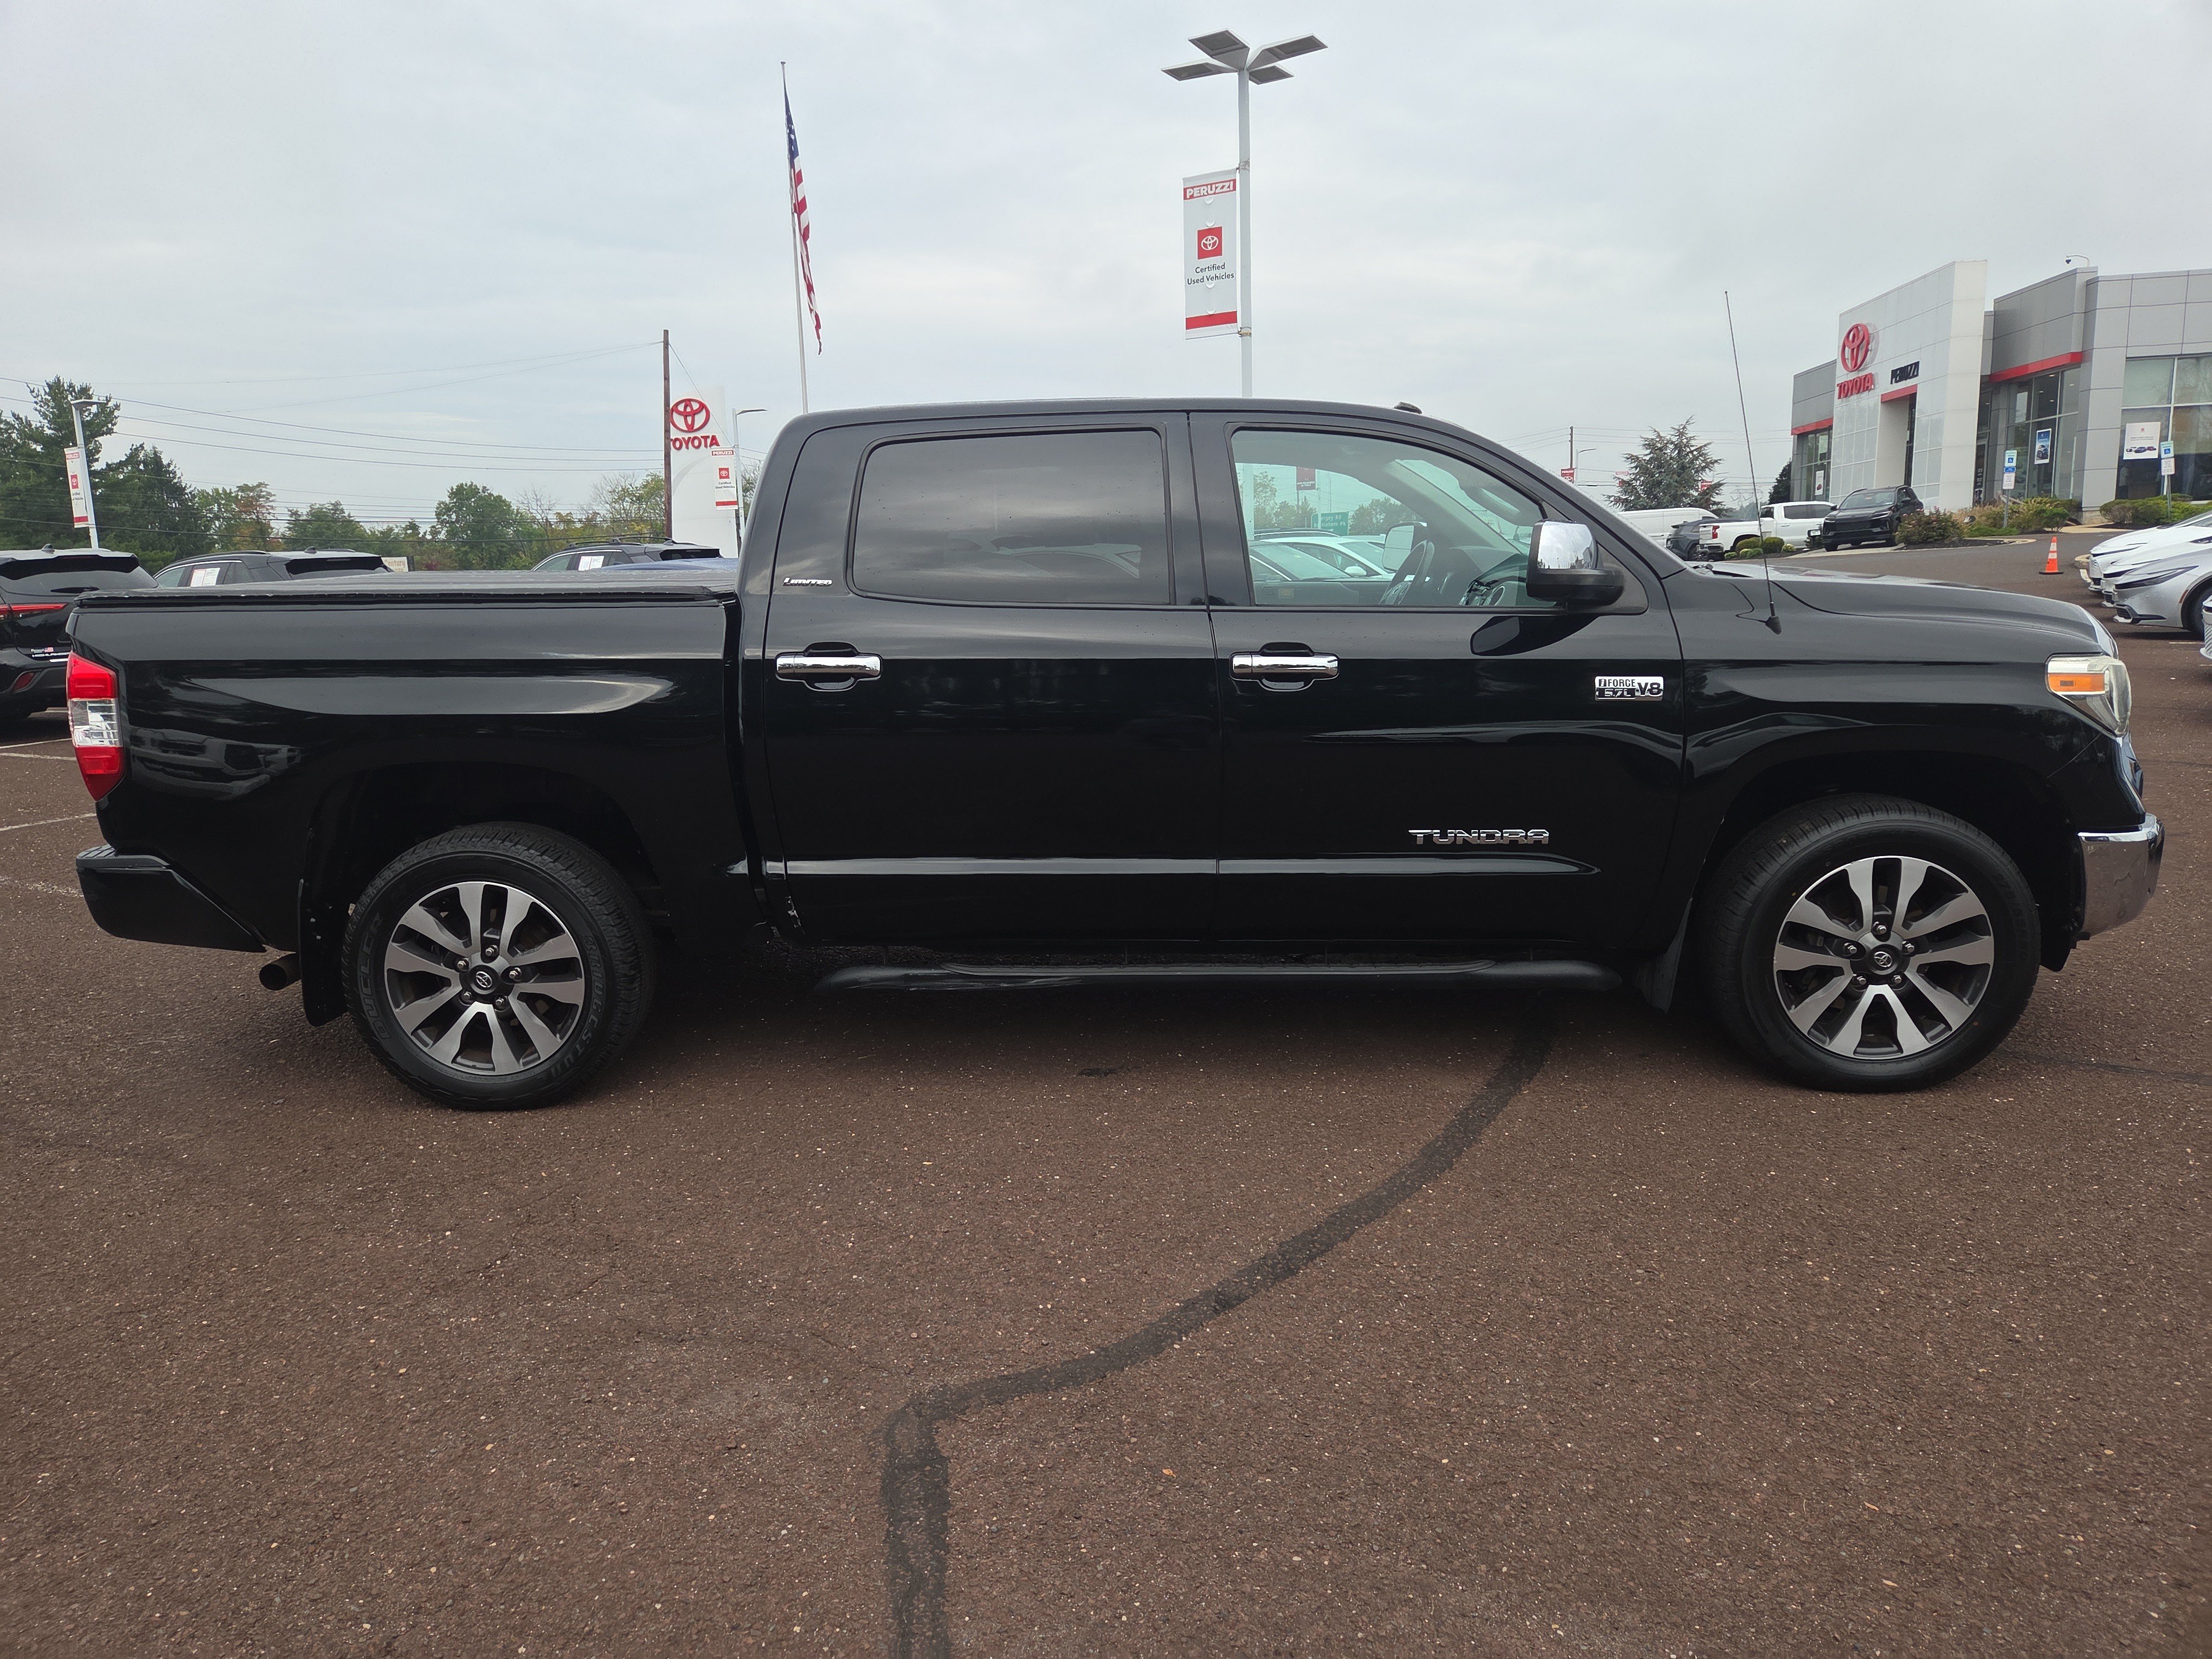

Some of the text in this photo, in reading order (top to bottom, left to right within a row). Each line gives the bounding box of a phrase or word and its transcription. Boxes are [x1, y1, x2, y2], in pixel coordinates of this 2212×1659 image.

[1186, 181, 1233, 198] PERUZZI
[1195, 262, 1225, 273] Certified
[1187, 272, 1234, 285] Used Vehicles
[1837, 372, 1874, 400] TOYOTA
[671, 435, 721, 451] OYOTA
[1637, 682, 1662, 697] V8
[1408, 829, 1549, 845] TUNDRA
